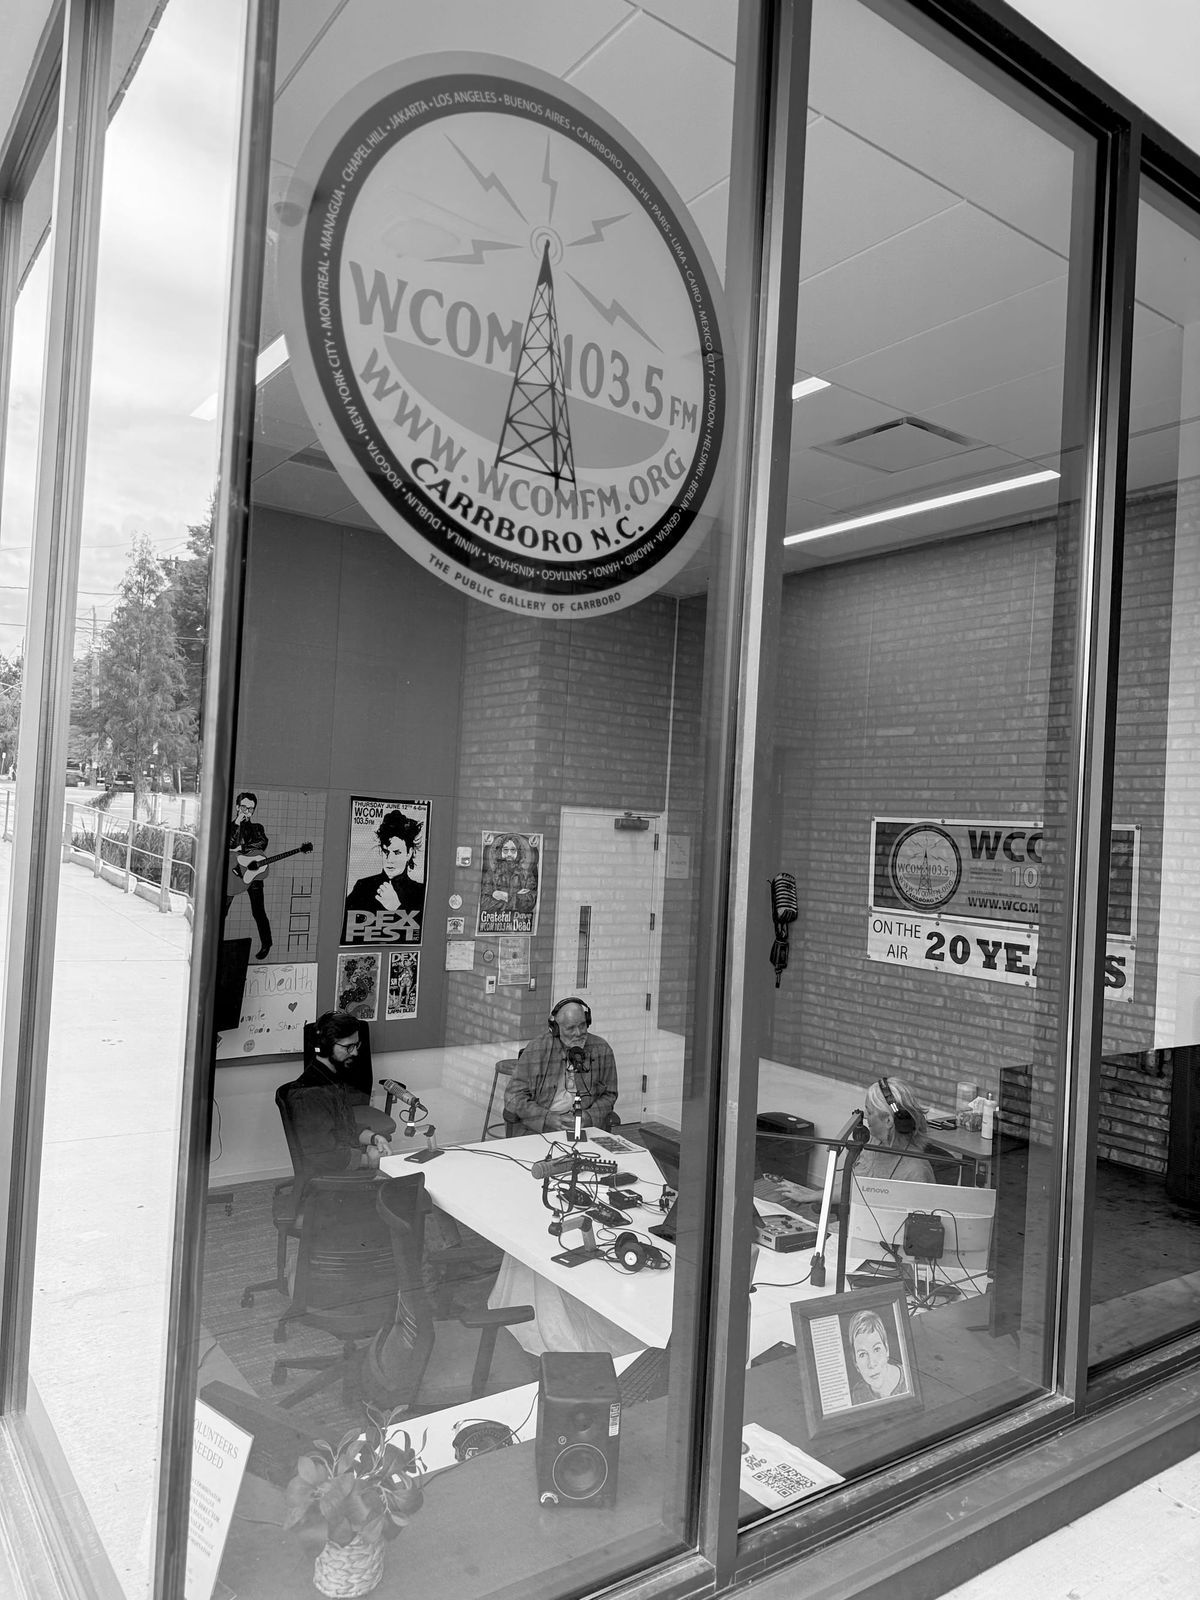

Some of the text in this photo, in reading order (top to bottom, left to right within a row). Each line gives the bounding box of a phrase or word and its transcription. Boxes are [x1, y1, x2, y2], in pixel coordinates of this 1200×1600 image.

[317, 91, 717, 581] CHAPEL HILL JAKARTA LOS ANGELES BUENOS AIRES CARRBORO DELHI PARIS LIMA CAIRO MEXICO CITY LONDON HELSINKI BERLIN GENEVA MADRID HANOI SANTIAGO KINSHASA MINILA DUBLIN BOGOTA NEW YORK CITY MONTREAL MANAGUA
[349, 261, 698, 434] WCOM 103.5 FM
[359, 348, 686, 520] WWW.WCOMFM.ORG
[411, 457, 644, 554] CARRBORO N.C.
[428, 553, 621, 612] THE PUBLIC GALLERY OF CARRBORO
[354, 808, 383, 818] WCOM
[347, 910, 420, 929] DEX
[481, 911, 532, 922] Grateful Dave
[513, 919, 531, 931] Dead
[346, 926, 413, 941] FEST
[873, 919, 921, 939] ON THE
[392, 953, 417, 962] DEX
[886, 944, 908, 960] AIR
[925, 931, 971, 965] 20
[264, 967, 314, 992] Wealth
[862, 1186, 889, 1194] Lenovo
[194, 1418, 239, 1460] OLUNTEERS
